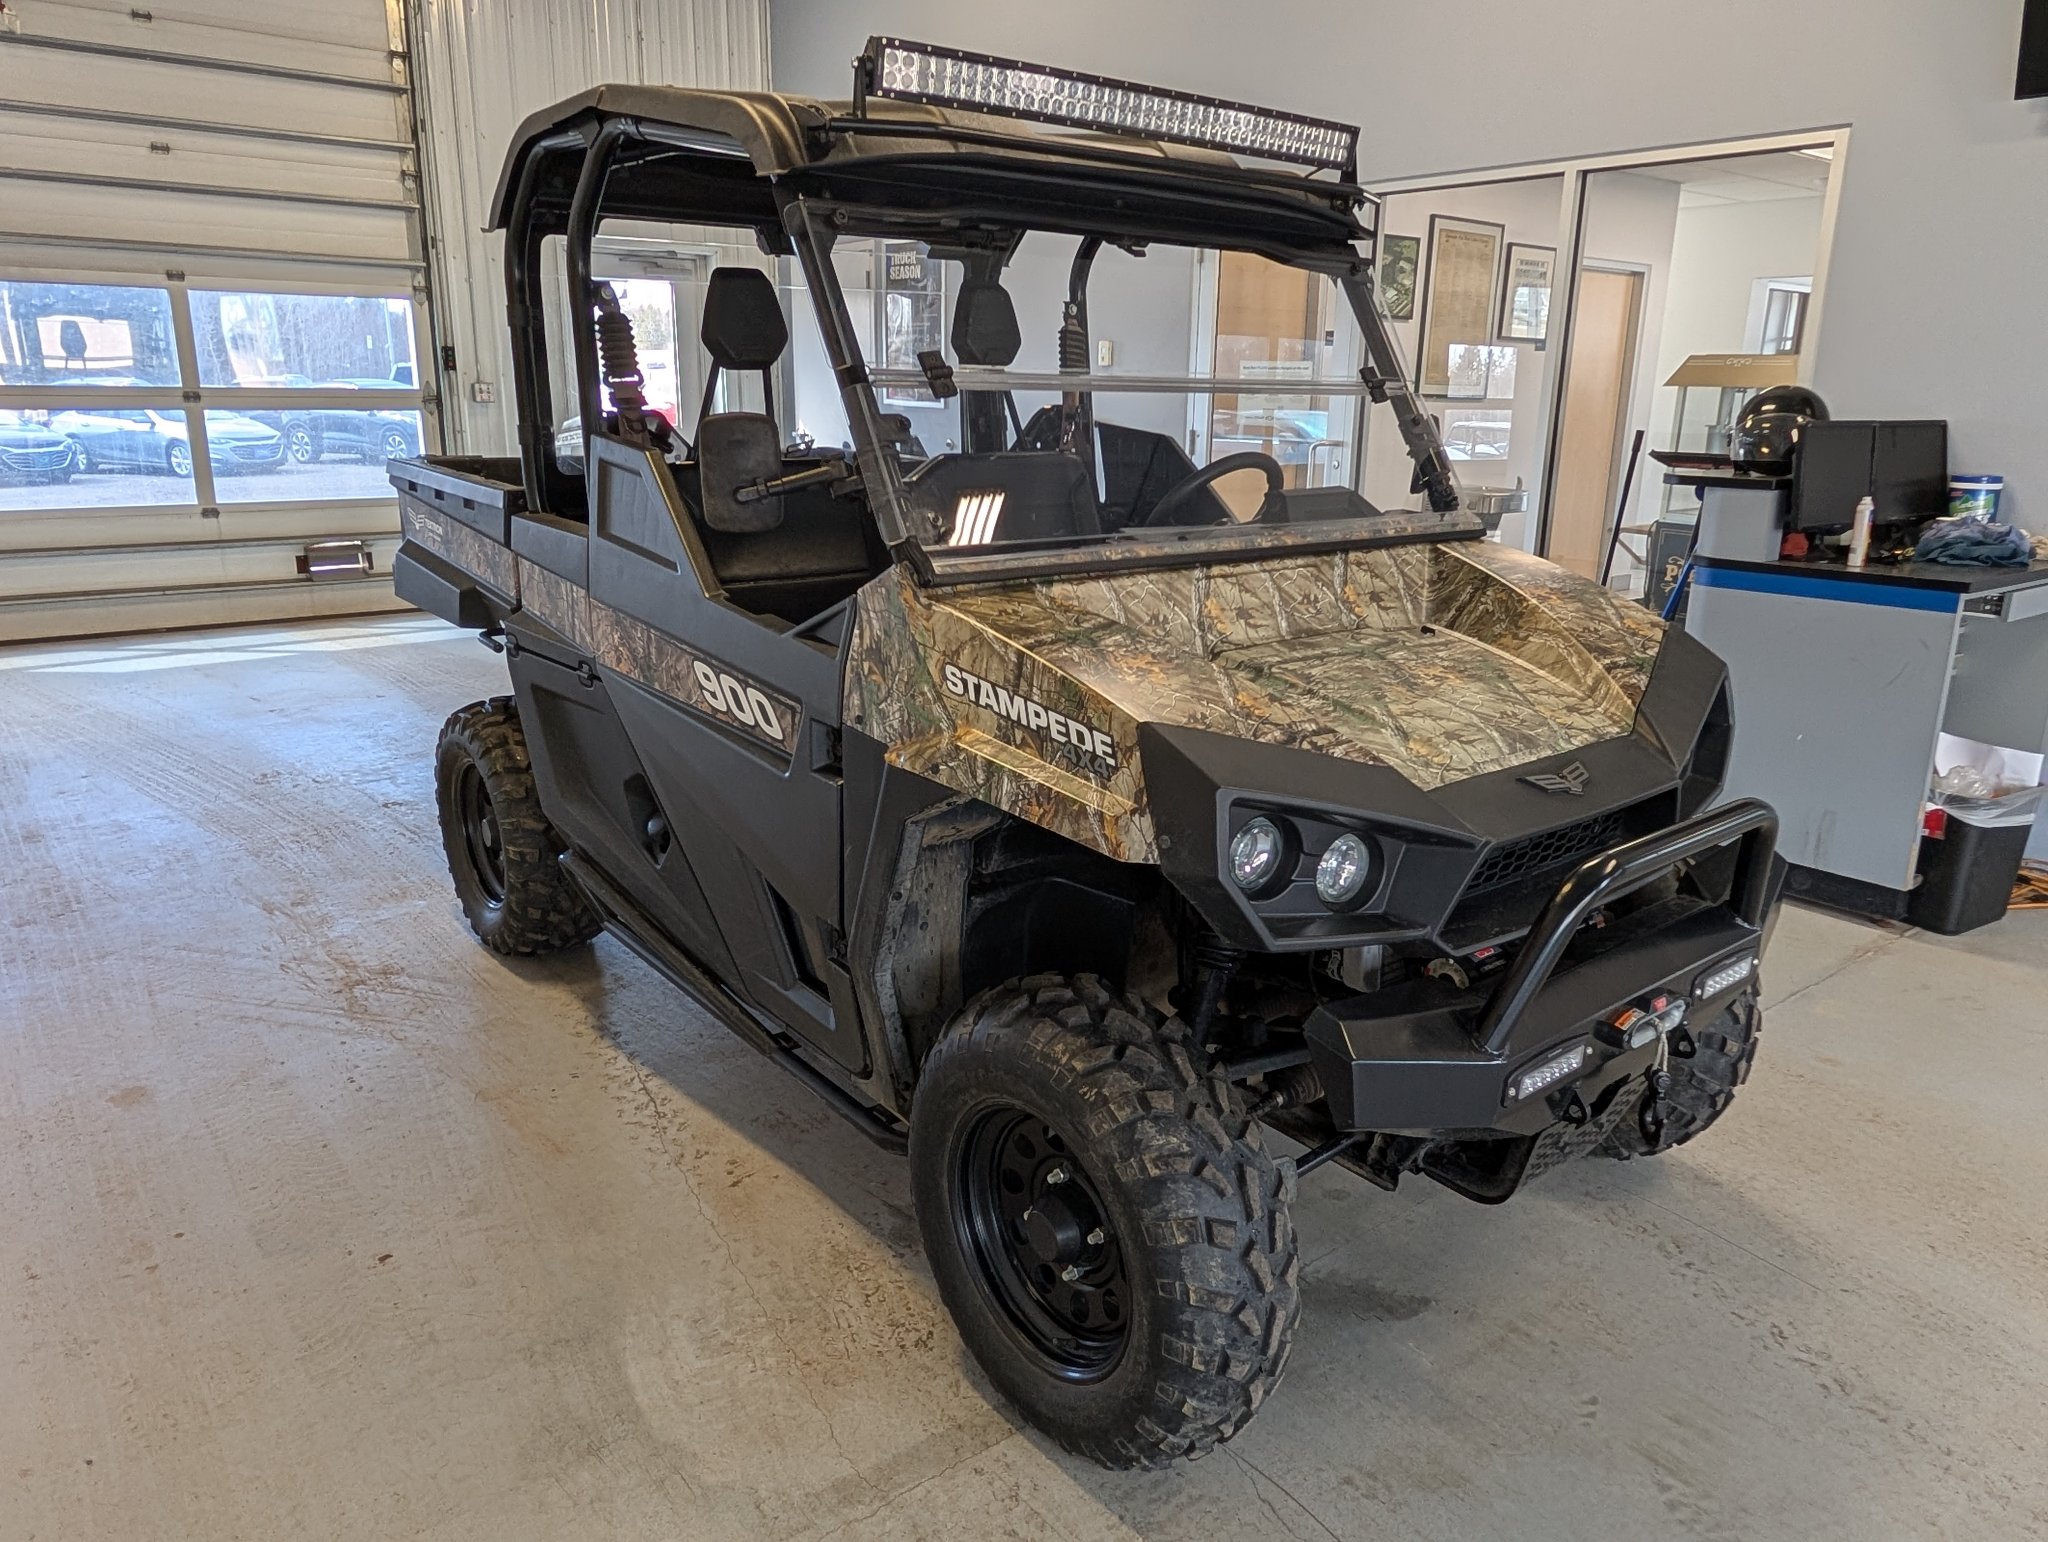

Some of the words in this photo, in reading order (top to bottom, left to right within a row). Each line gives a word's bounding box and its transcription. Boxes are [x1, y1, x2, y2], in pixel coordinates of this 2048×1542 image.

[889, 264, 921, 280] SEASON
[891, 250, 916, 265] TRUCK
[693, 660, 783, 740] 900
[945, 664, 1116, 767] STAMPEDE
